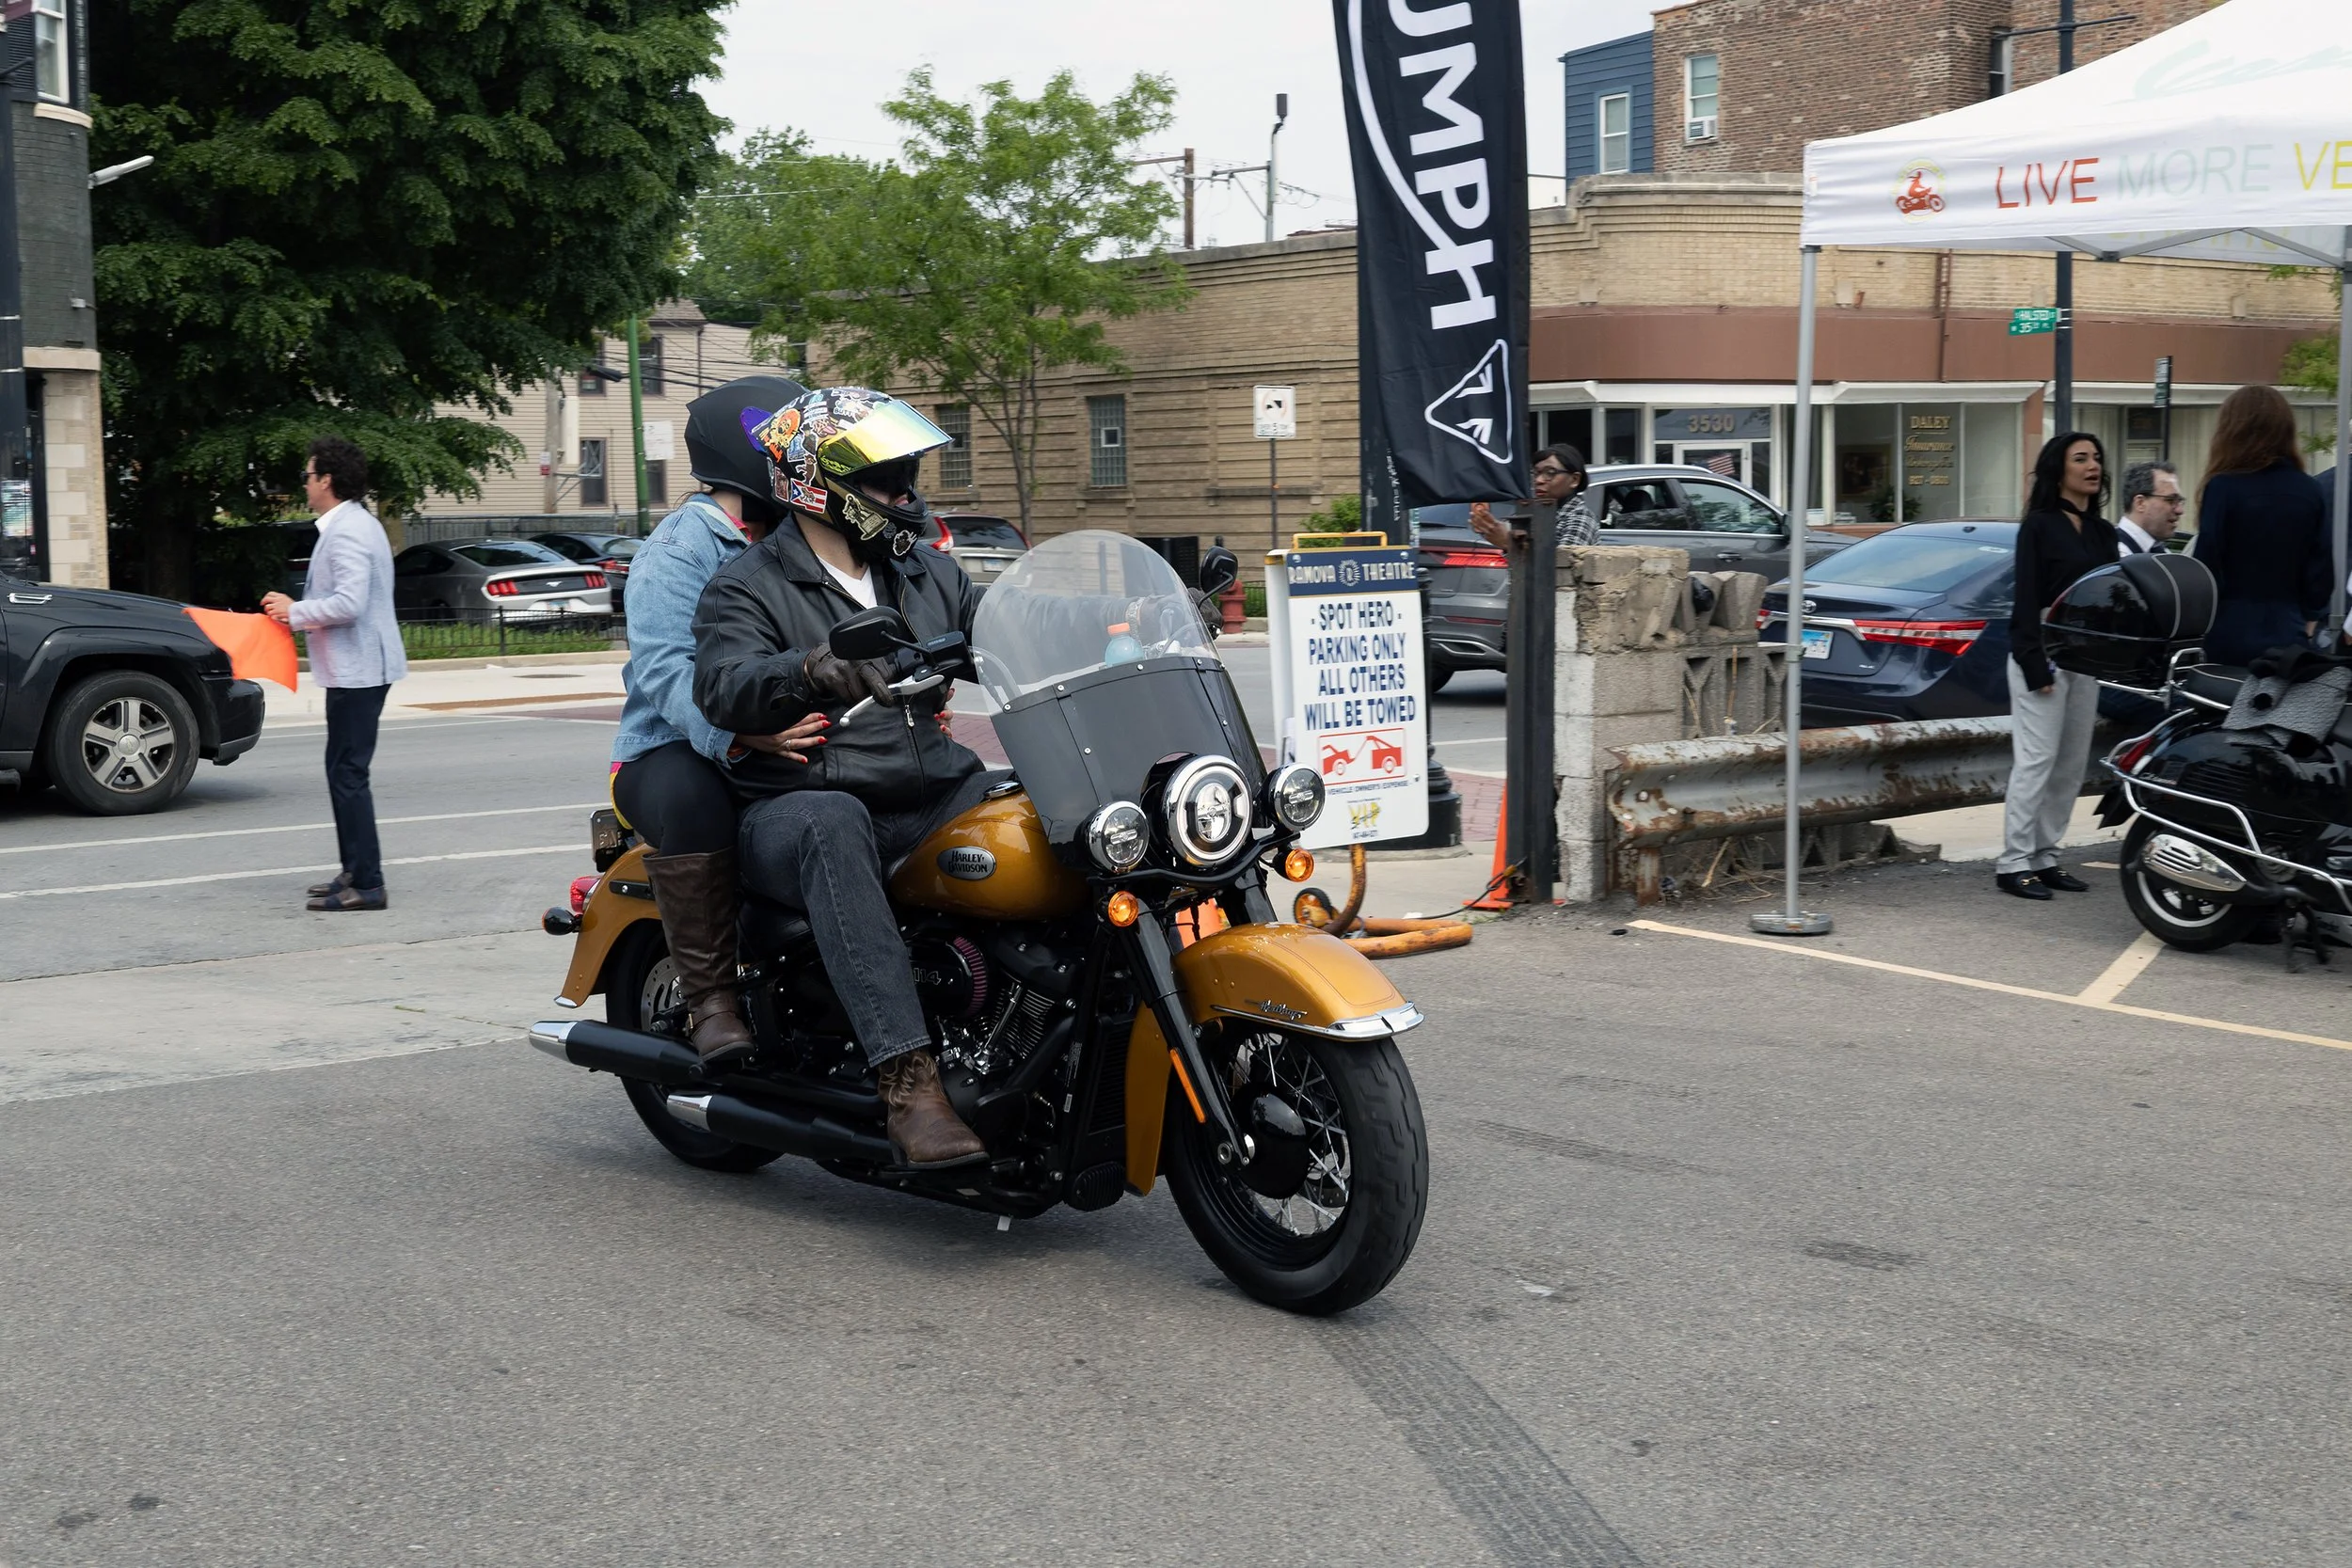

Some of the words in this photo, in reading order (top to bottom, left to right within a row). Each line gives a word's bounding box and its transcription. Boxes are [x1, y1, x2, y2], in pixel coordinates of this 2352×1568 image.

[1994, 157, 2100, 209] LIVE
[2117, 143, 2275, 200] MORE
[1688, 414, 1735, 434] 3530
[1910, 416, 1951, 430] DALEY
[1361, 562, 1417, 581] THEATRE
[1319, 603, 1353, 631] SPOT
[1358, 600, 1394, 628] HERO
[1309, 634, 1369, 665] PARKING
[1373, 632, 1406, 660] ONLY
[1318, 669, 1344, 696] ALL
[1350, 663, 1406, 693] OTHERS
[1304, 702, 1340, 731] WILL
[1344, 700, 1362, 727] BE
[1367, 695, 1416, 724] TOWED
[1382, 780, 1408, 790] EXPENSE
[948, 861, 988, 874] DAVIDSON
